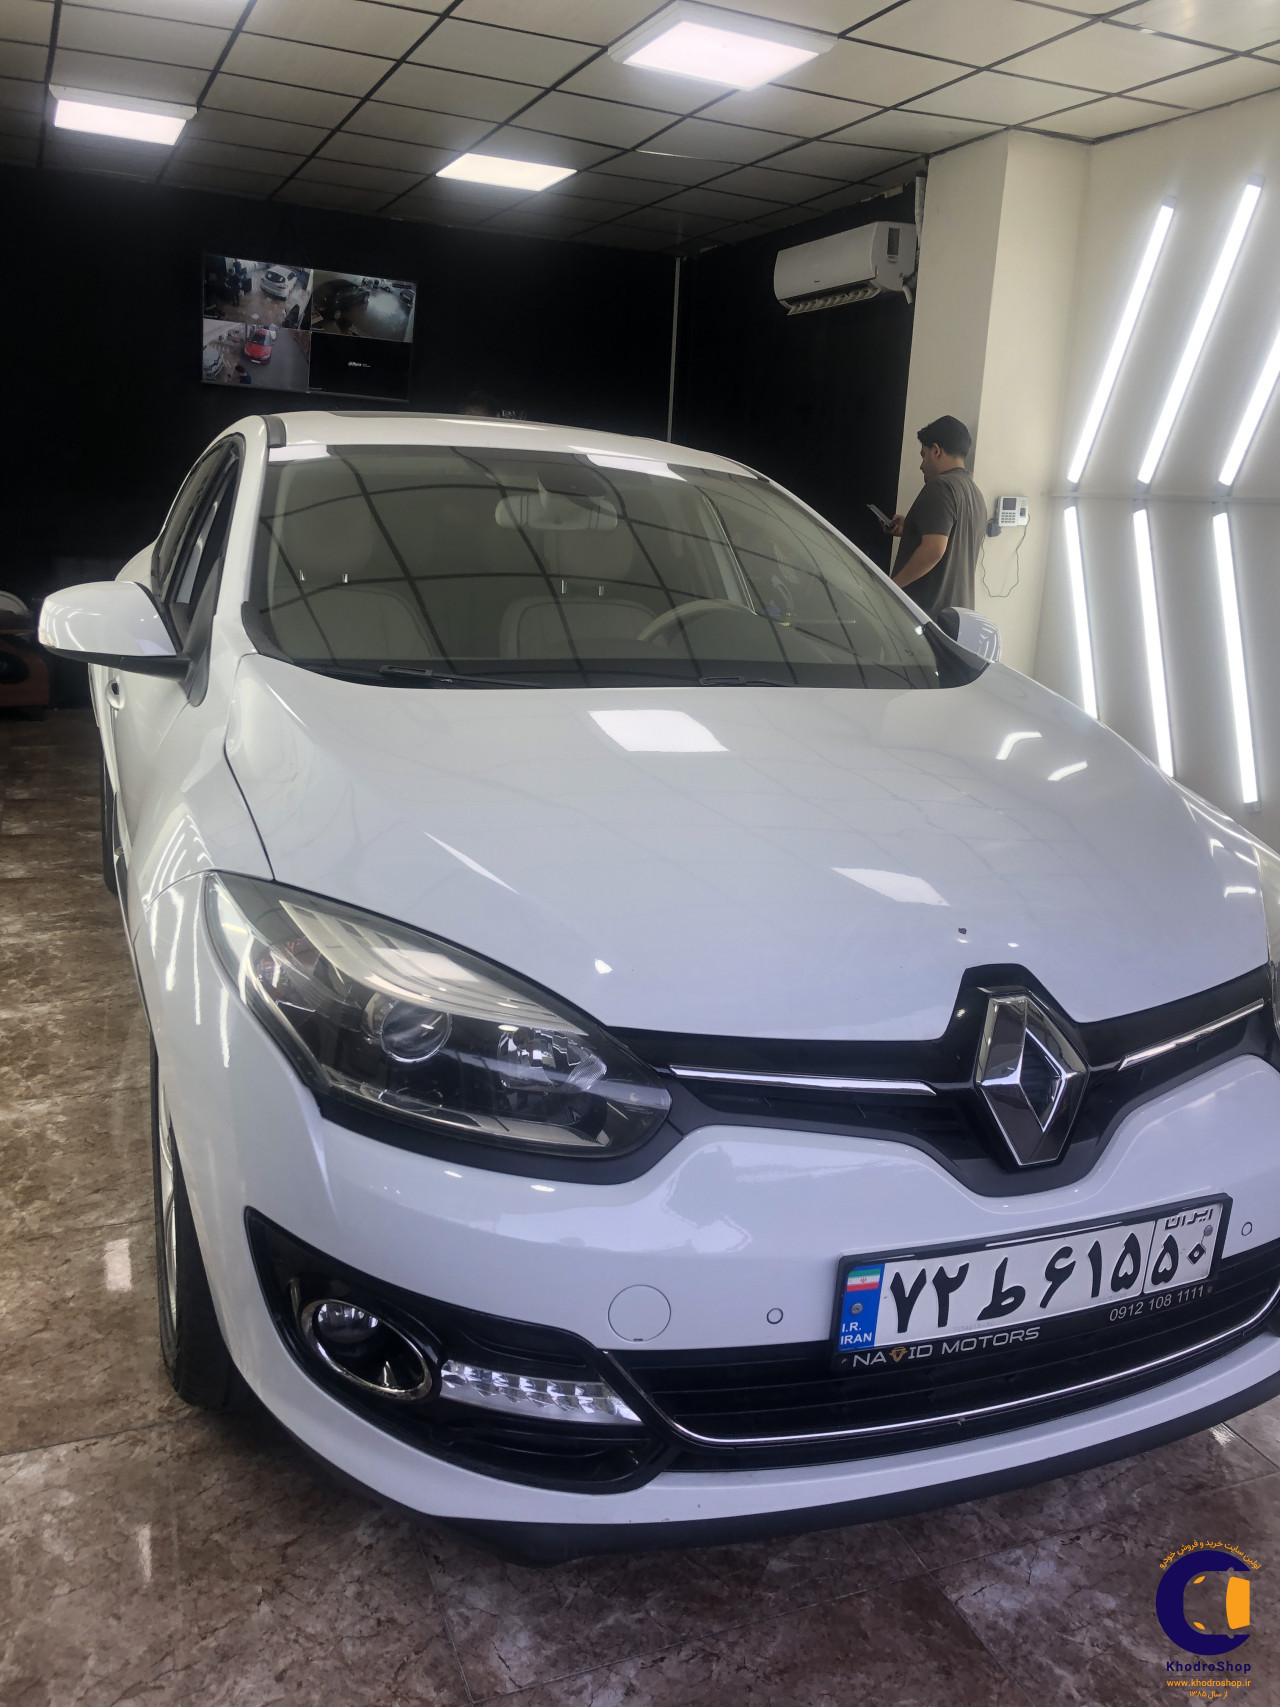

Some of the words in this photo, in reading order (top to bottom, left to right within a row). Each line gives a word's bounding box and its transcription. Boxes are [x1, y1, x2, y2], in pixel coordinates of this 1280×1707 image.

[1165, 1208, 1214, 1230] ایران
[1109, 1301, 1144, 1322] 0912
[1149, 1293, 1172, 1311] 108
[1177, 1284, 1204, 1303] 1111
[840, 1332, 873, 1345] IRAN
[841, 1322, 862, 1333] I.R.
[941, 1326, 1041, 1355] MOTORS
